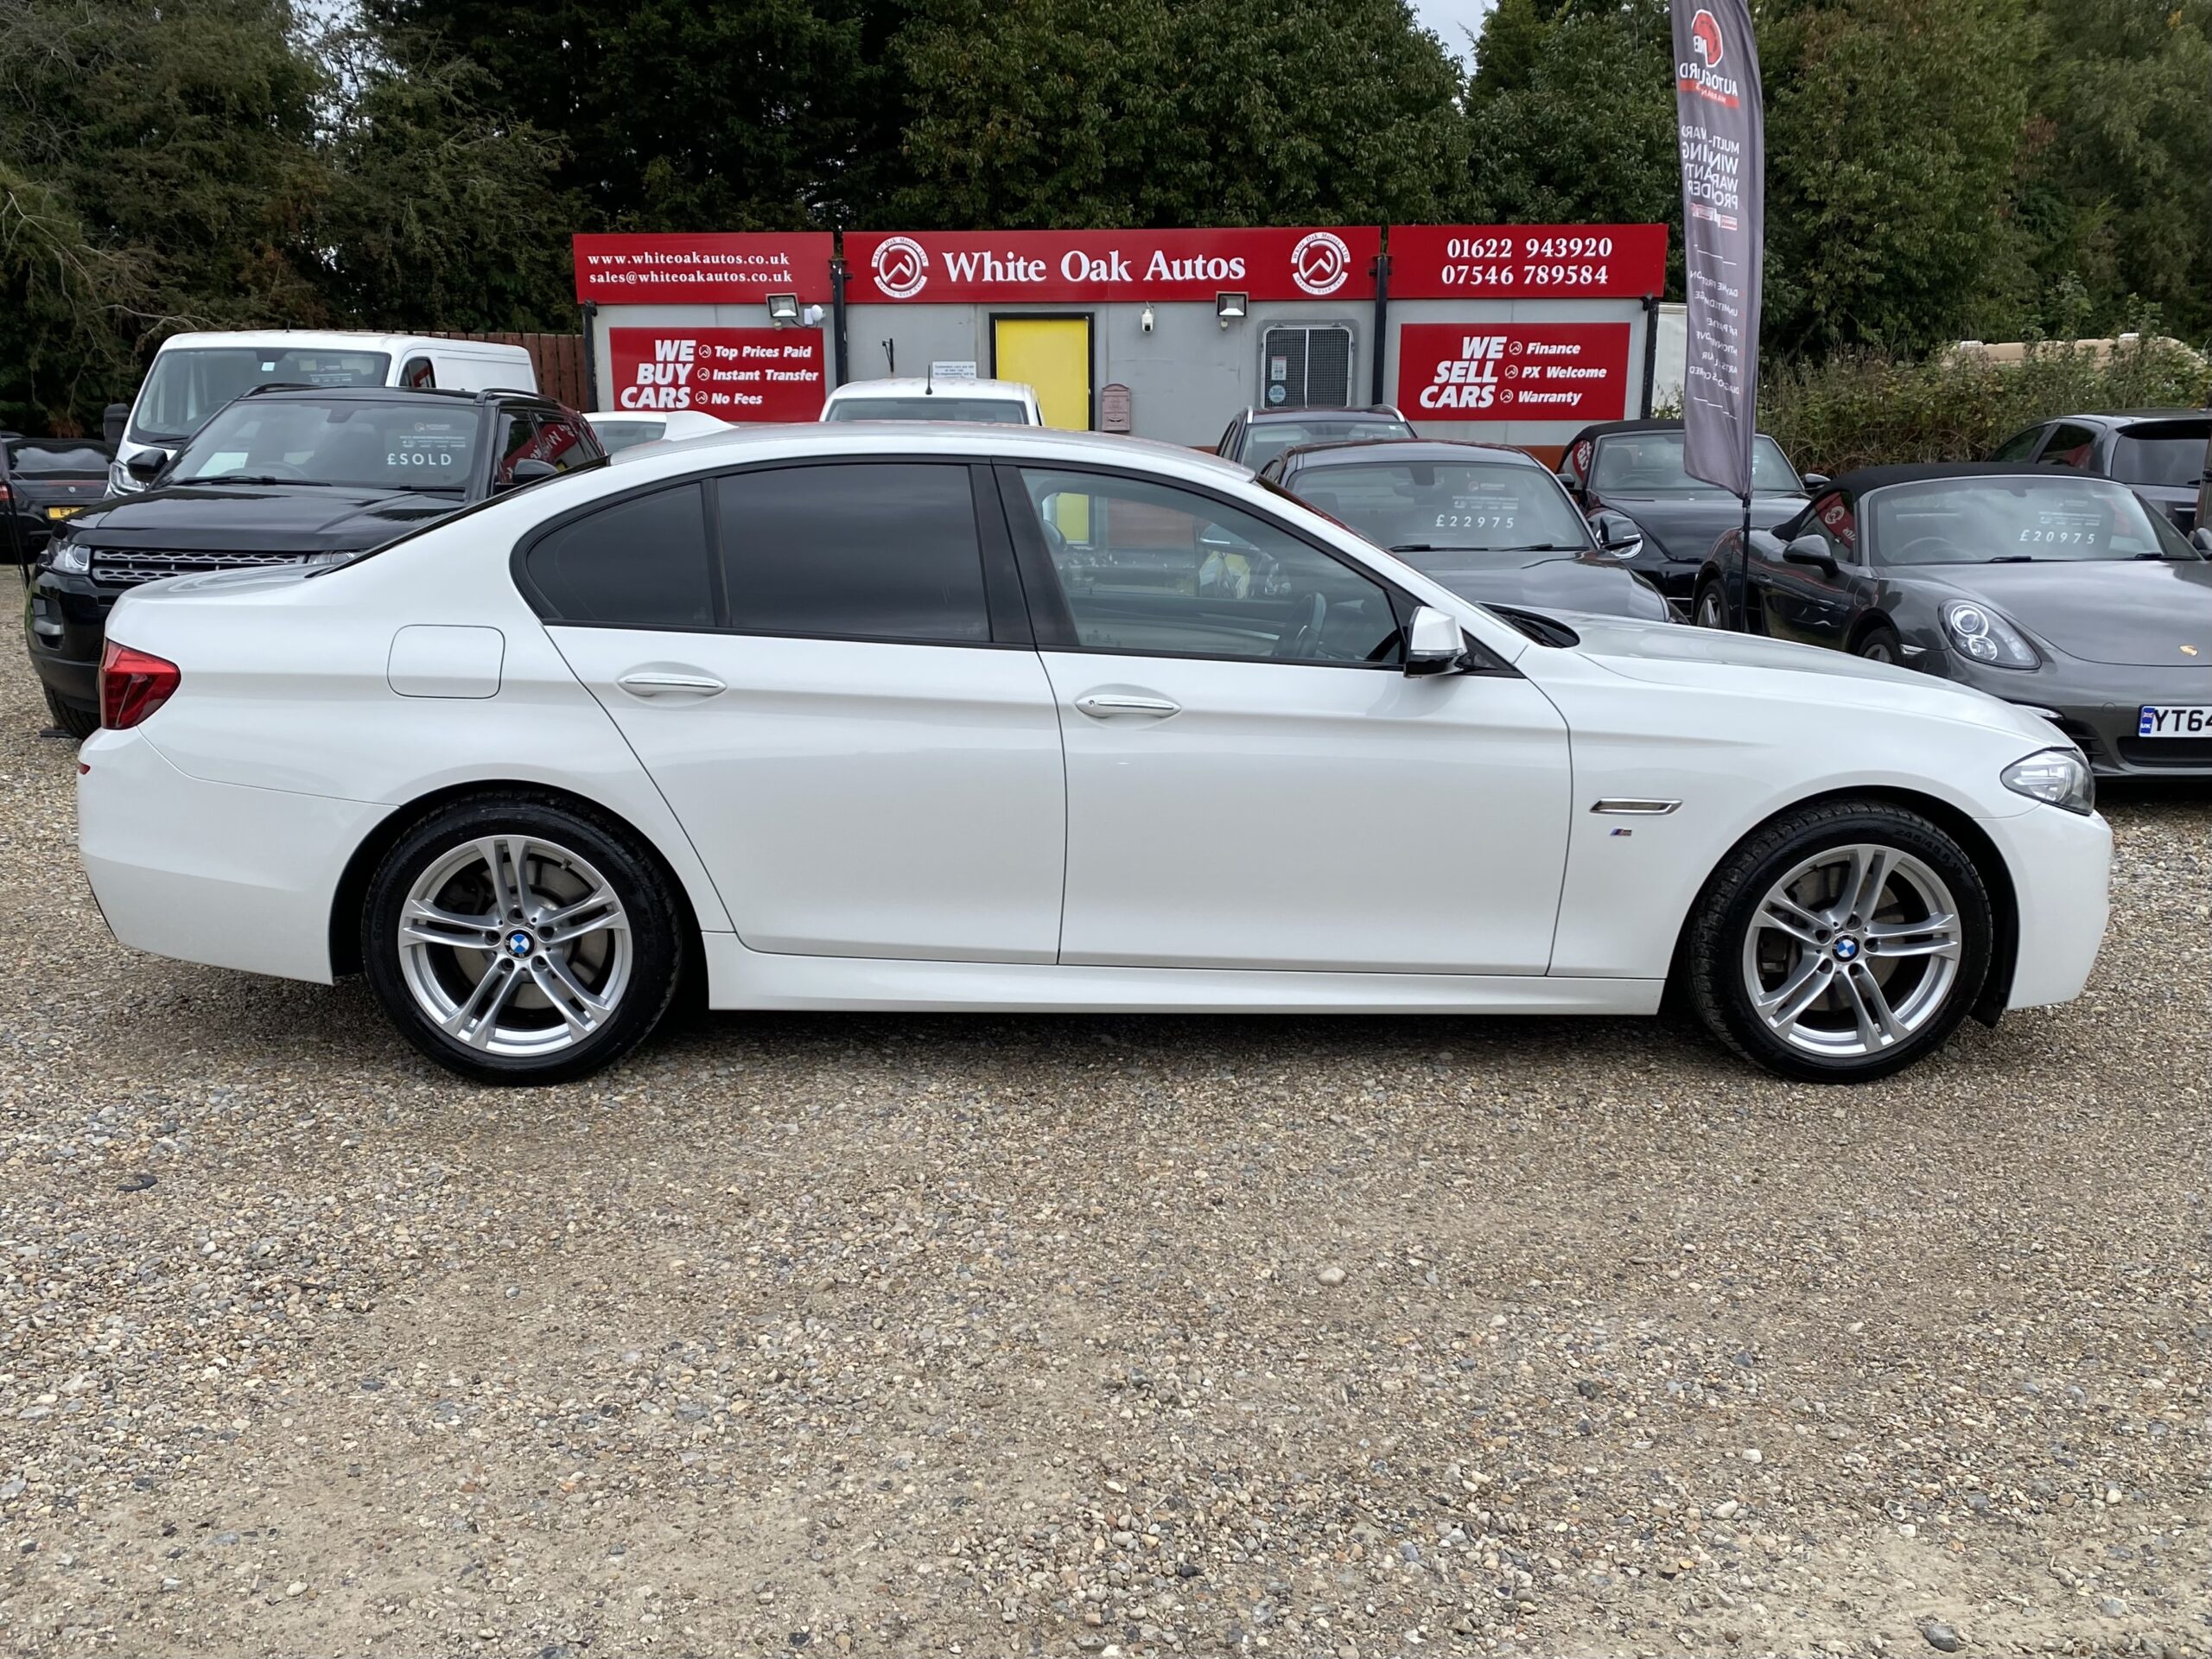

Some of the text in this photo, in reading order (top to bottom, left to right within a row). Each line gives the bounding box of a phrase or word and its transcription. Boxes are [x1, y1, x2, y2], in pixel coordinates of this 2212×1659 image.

[1446, 237, 1613, 258] 01622 943920
[588, 251, 790, 265] www.whiteoakautos.co.uk
[942, 250, 1245, 283] White Oak Autos
[589, 270, 792, 284] sales@whiteoakautos.co.uk
[1441, 264, 1608, 285] 07546 789584
[655, 340, 696, 362] WE
[715, 345, 811, 360] Top Prices Paid
[1462, 336, 1507, 359] WE
[1526, 342, 1580, 355] Finance
[636, 363, 694, 385] BUY
[713, 369, 819, 382] Instant Transfer
[1433, 360, 1498, 384] SELL
[1522, 366, 1607, 378] PX Welcome
[620, 387, 690, 409] CARS
[711, 392, 762, 405] No Fees
[1420, 385, 1496, 409] CARS
[1518, 391, 1582, 406] Warranty
[387, 453, 452, 466] £SOLD
[1435, 514, 1514, 529] £22975
[2018, 529, 2095, 544] £20975
